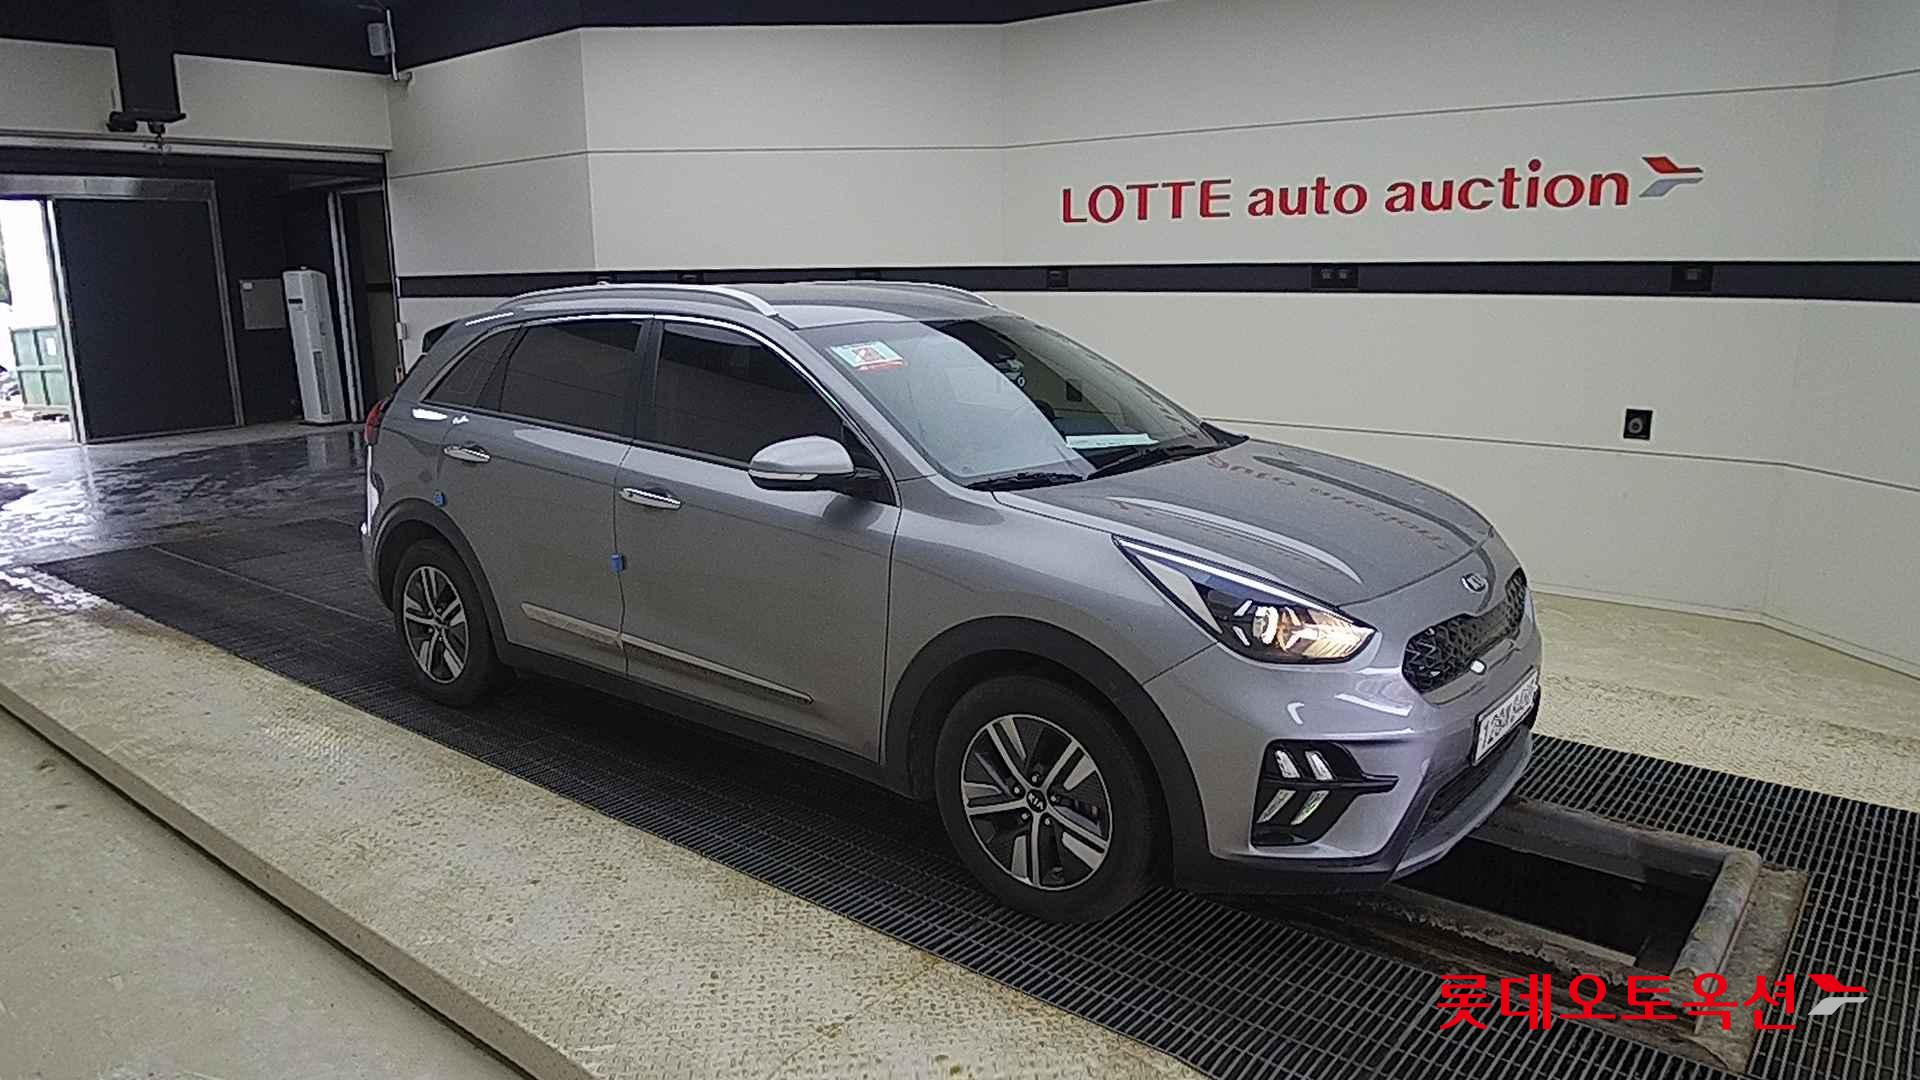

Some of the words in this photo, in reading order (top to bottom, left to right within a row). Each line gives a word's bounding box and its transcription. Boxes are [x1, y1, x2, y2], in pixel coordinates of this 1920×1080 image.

[1062, 178, 1231, 223] LOTTE
[1247, 176, 1368, 216] auto
[1384, 159, 1630, 214] auction
